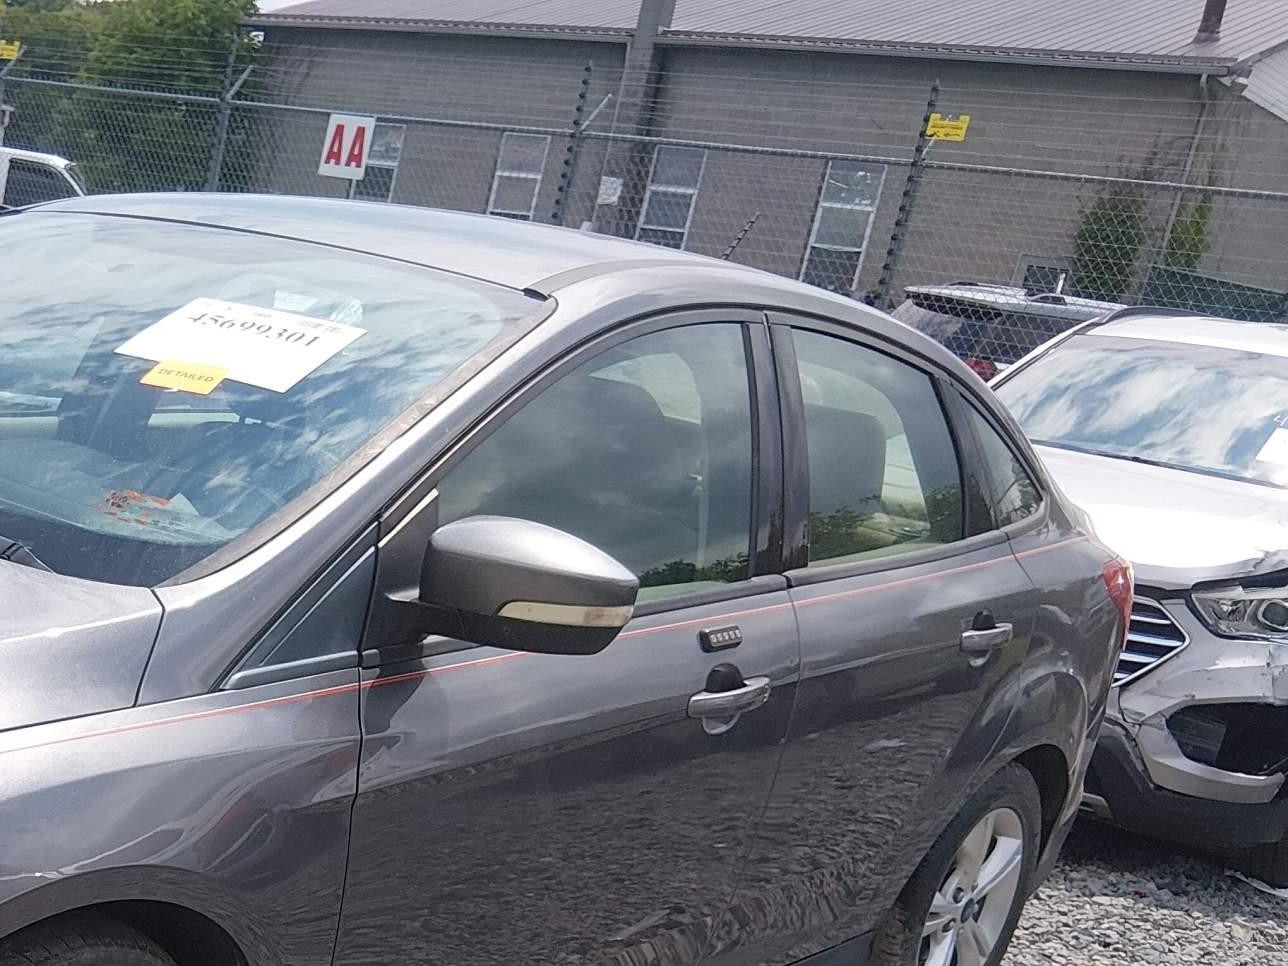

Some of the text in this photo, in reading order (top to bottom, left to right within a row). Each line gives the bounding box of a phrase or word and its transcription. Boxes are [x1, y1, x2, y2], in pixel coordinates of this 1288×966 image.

[324, 123, 366, 168] AA
[187, 312, 320, 347] 45699301
[158, 368, 214, 382] DETAILED
